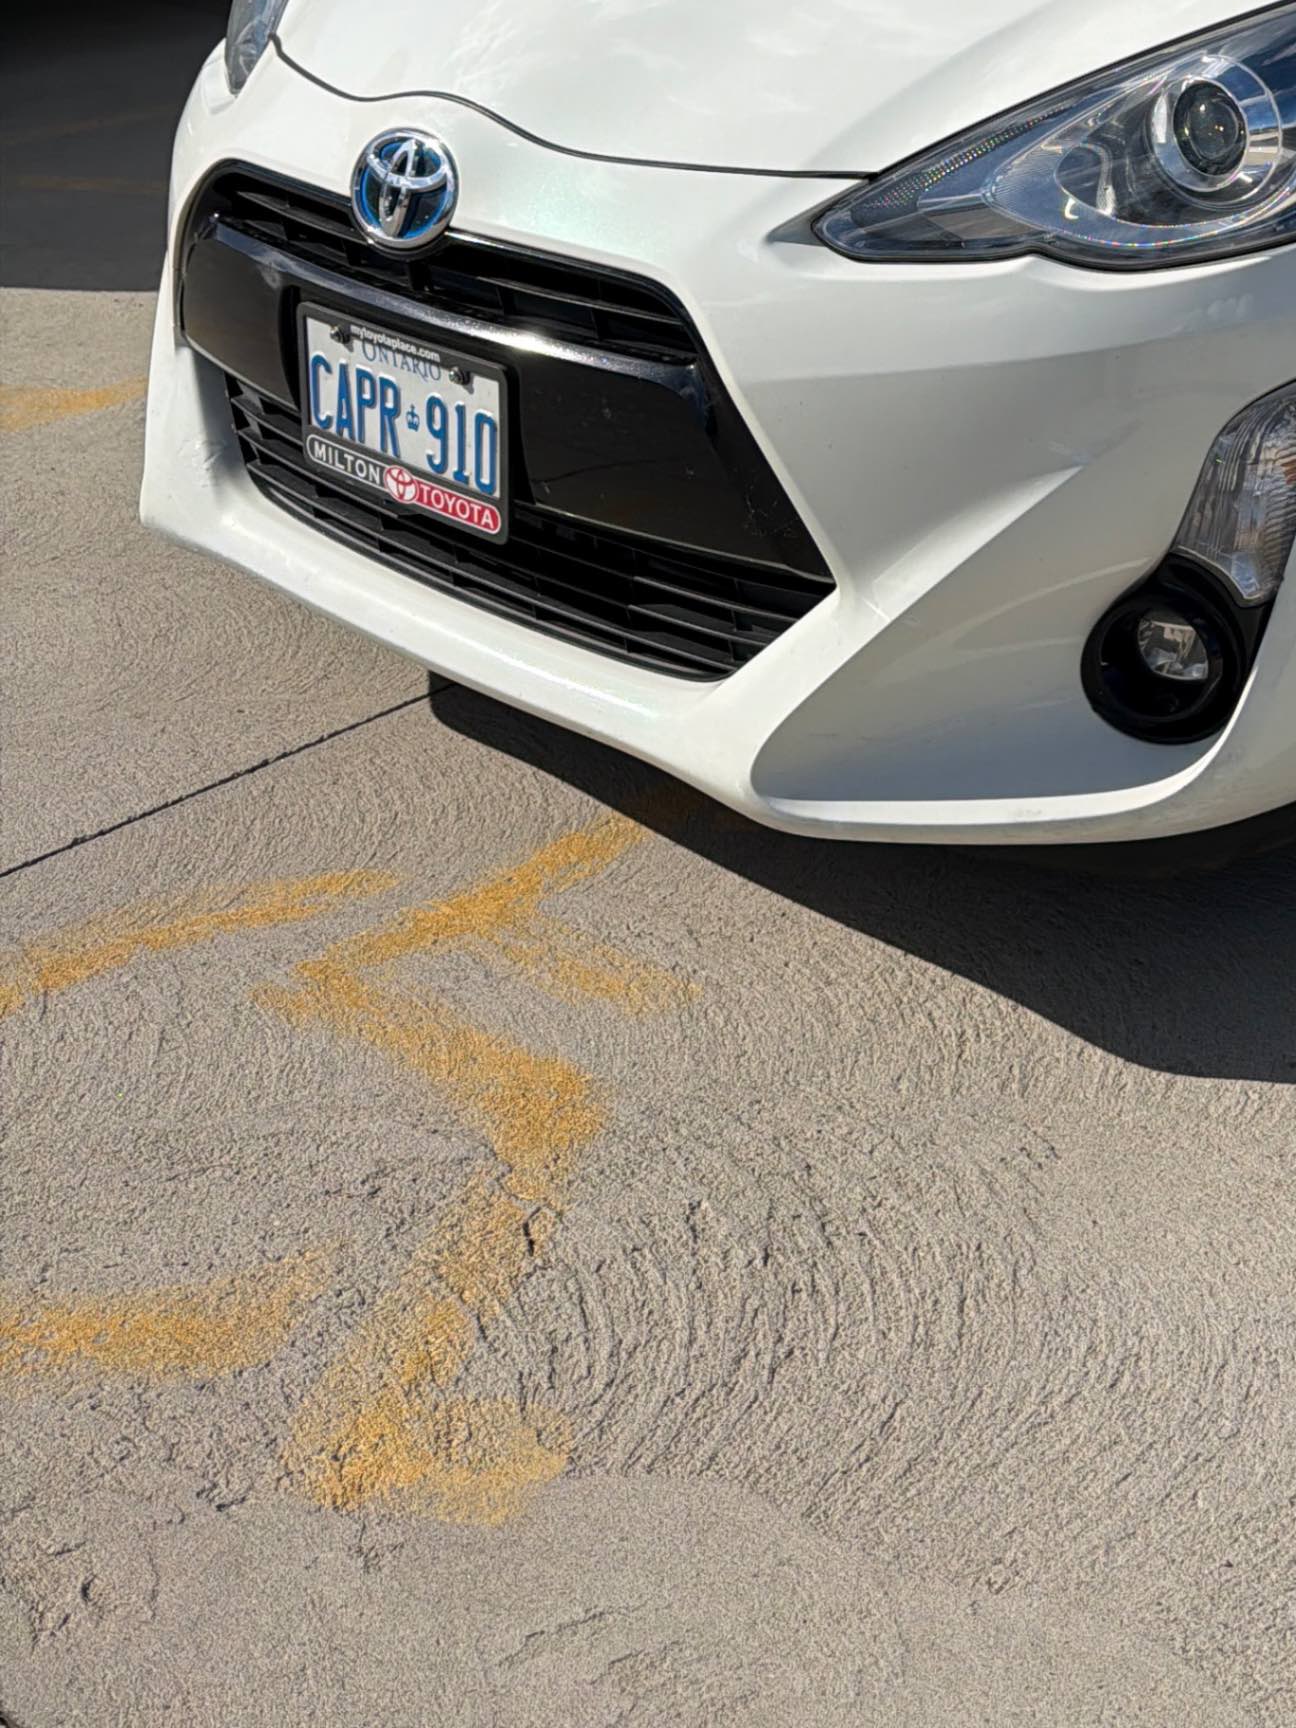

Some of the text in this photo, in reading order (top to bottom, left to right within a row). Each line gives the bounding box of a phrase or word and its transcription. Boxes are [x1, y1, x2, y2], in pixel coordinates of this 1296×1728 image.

[350, 324, 441, 363] mytoyotaplace.com
[362, 339, 442, 383] ONTARIO
[310, 352, 498, 497] CAPR 910
[313, 442, 495, 529] MILTON TOYOTA
